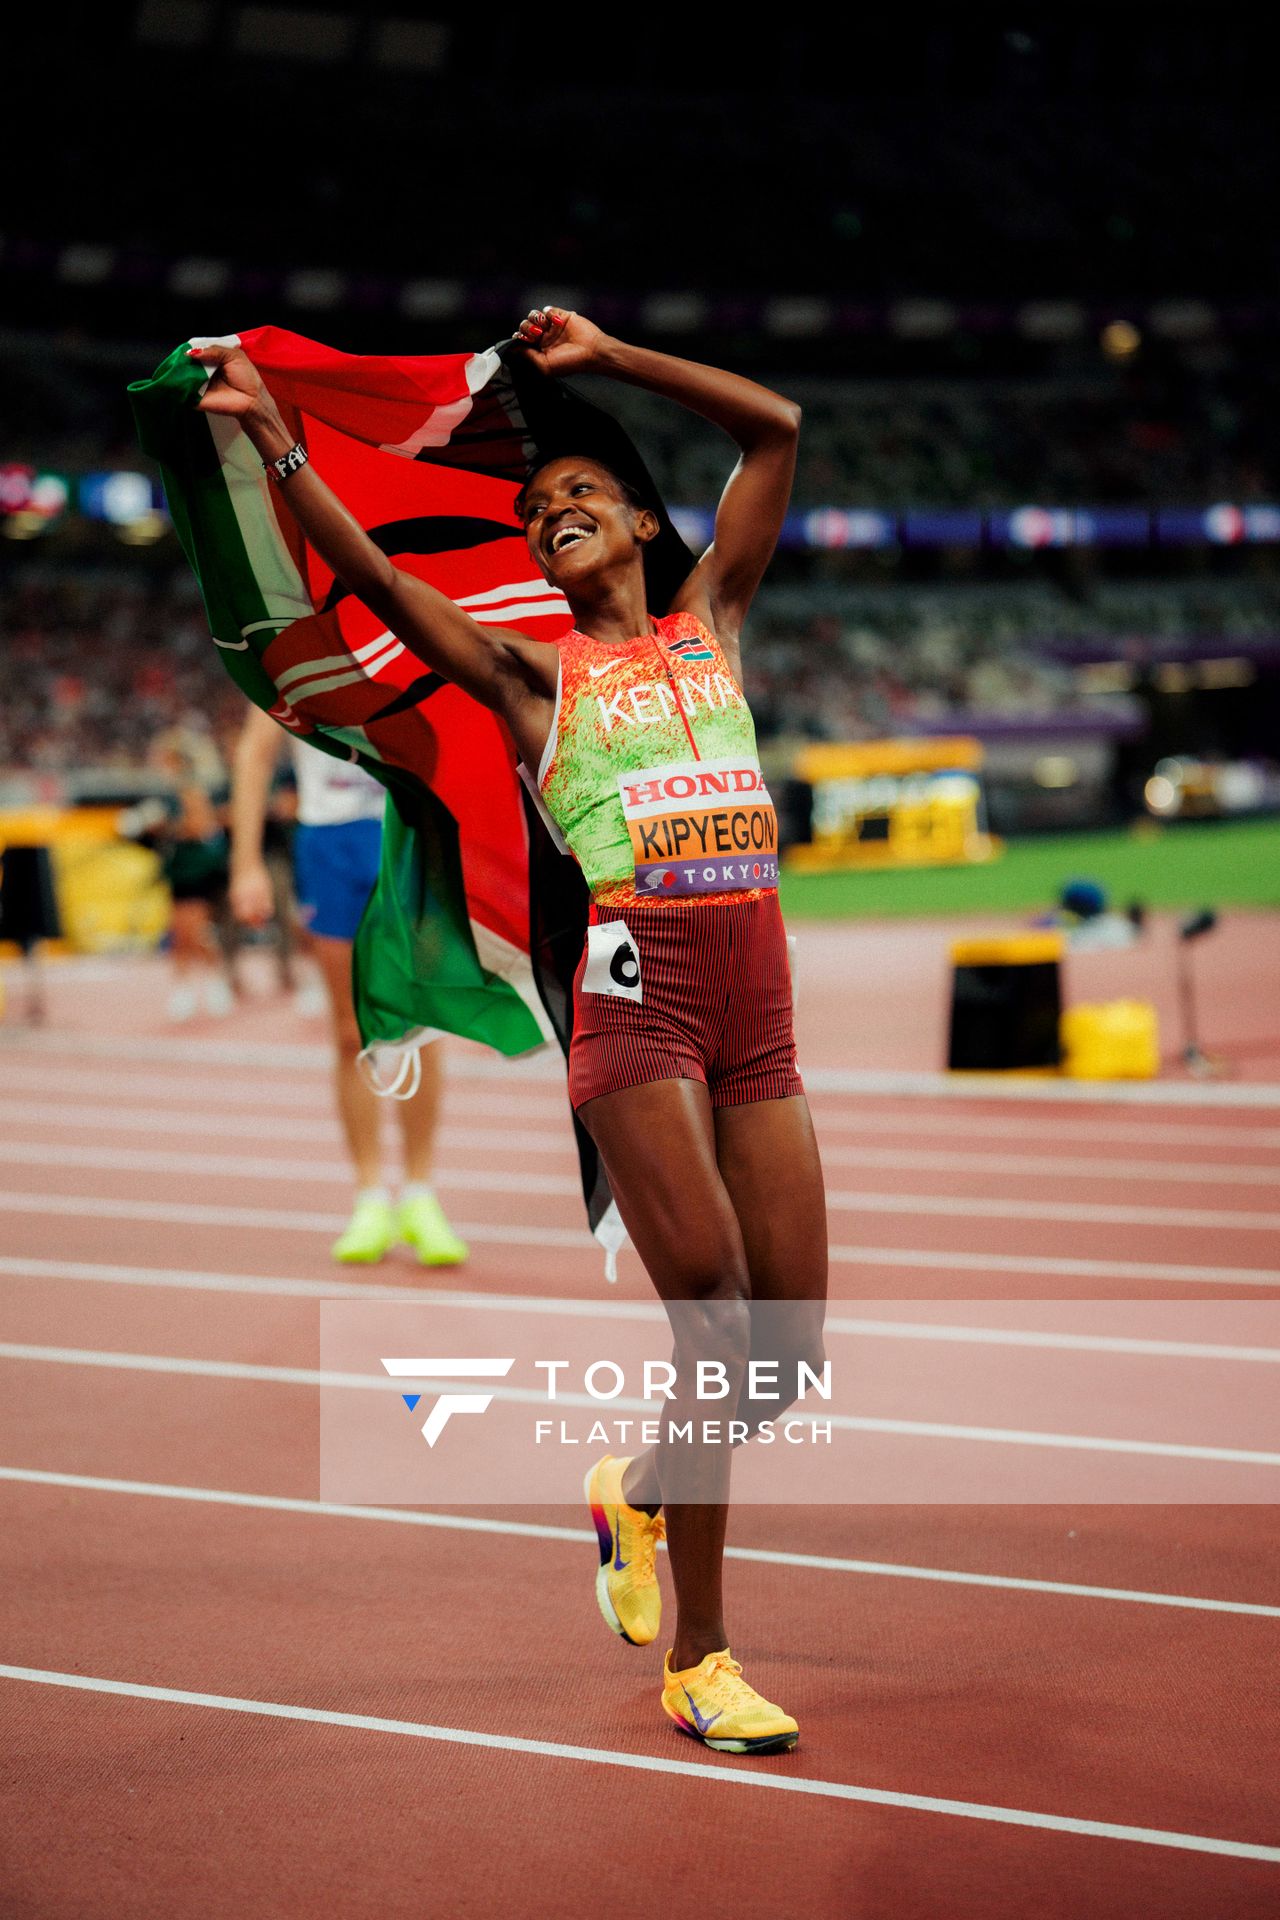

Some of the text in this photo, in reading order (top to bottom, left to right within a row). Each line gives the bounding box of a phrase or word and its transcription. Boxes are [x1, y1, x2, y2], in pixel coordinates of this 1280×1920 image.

[597, 672, 744, 732] KENYA
[638, 811, 775, 859] KIPYEGON
[610, 941, 640, 988] 6
